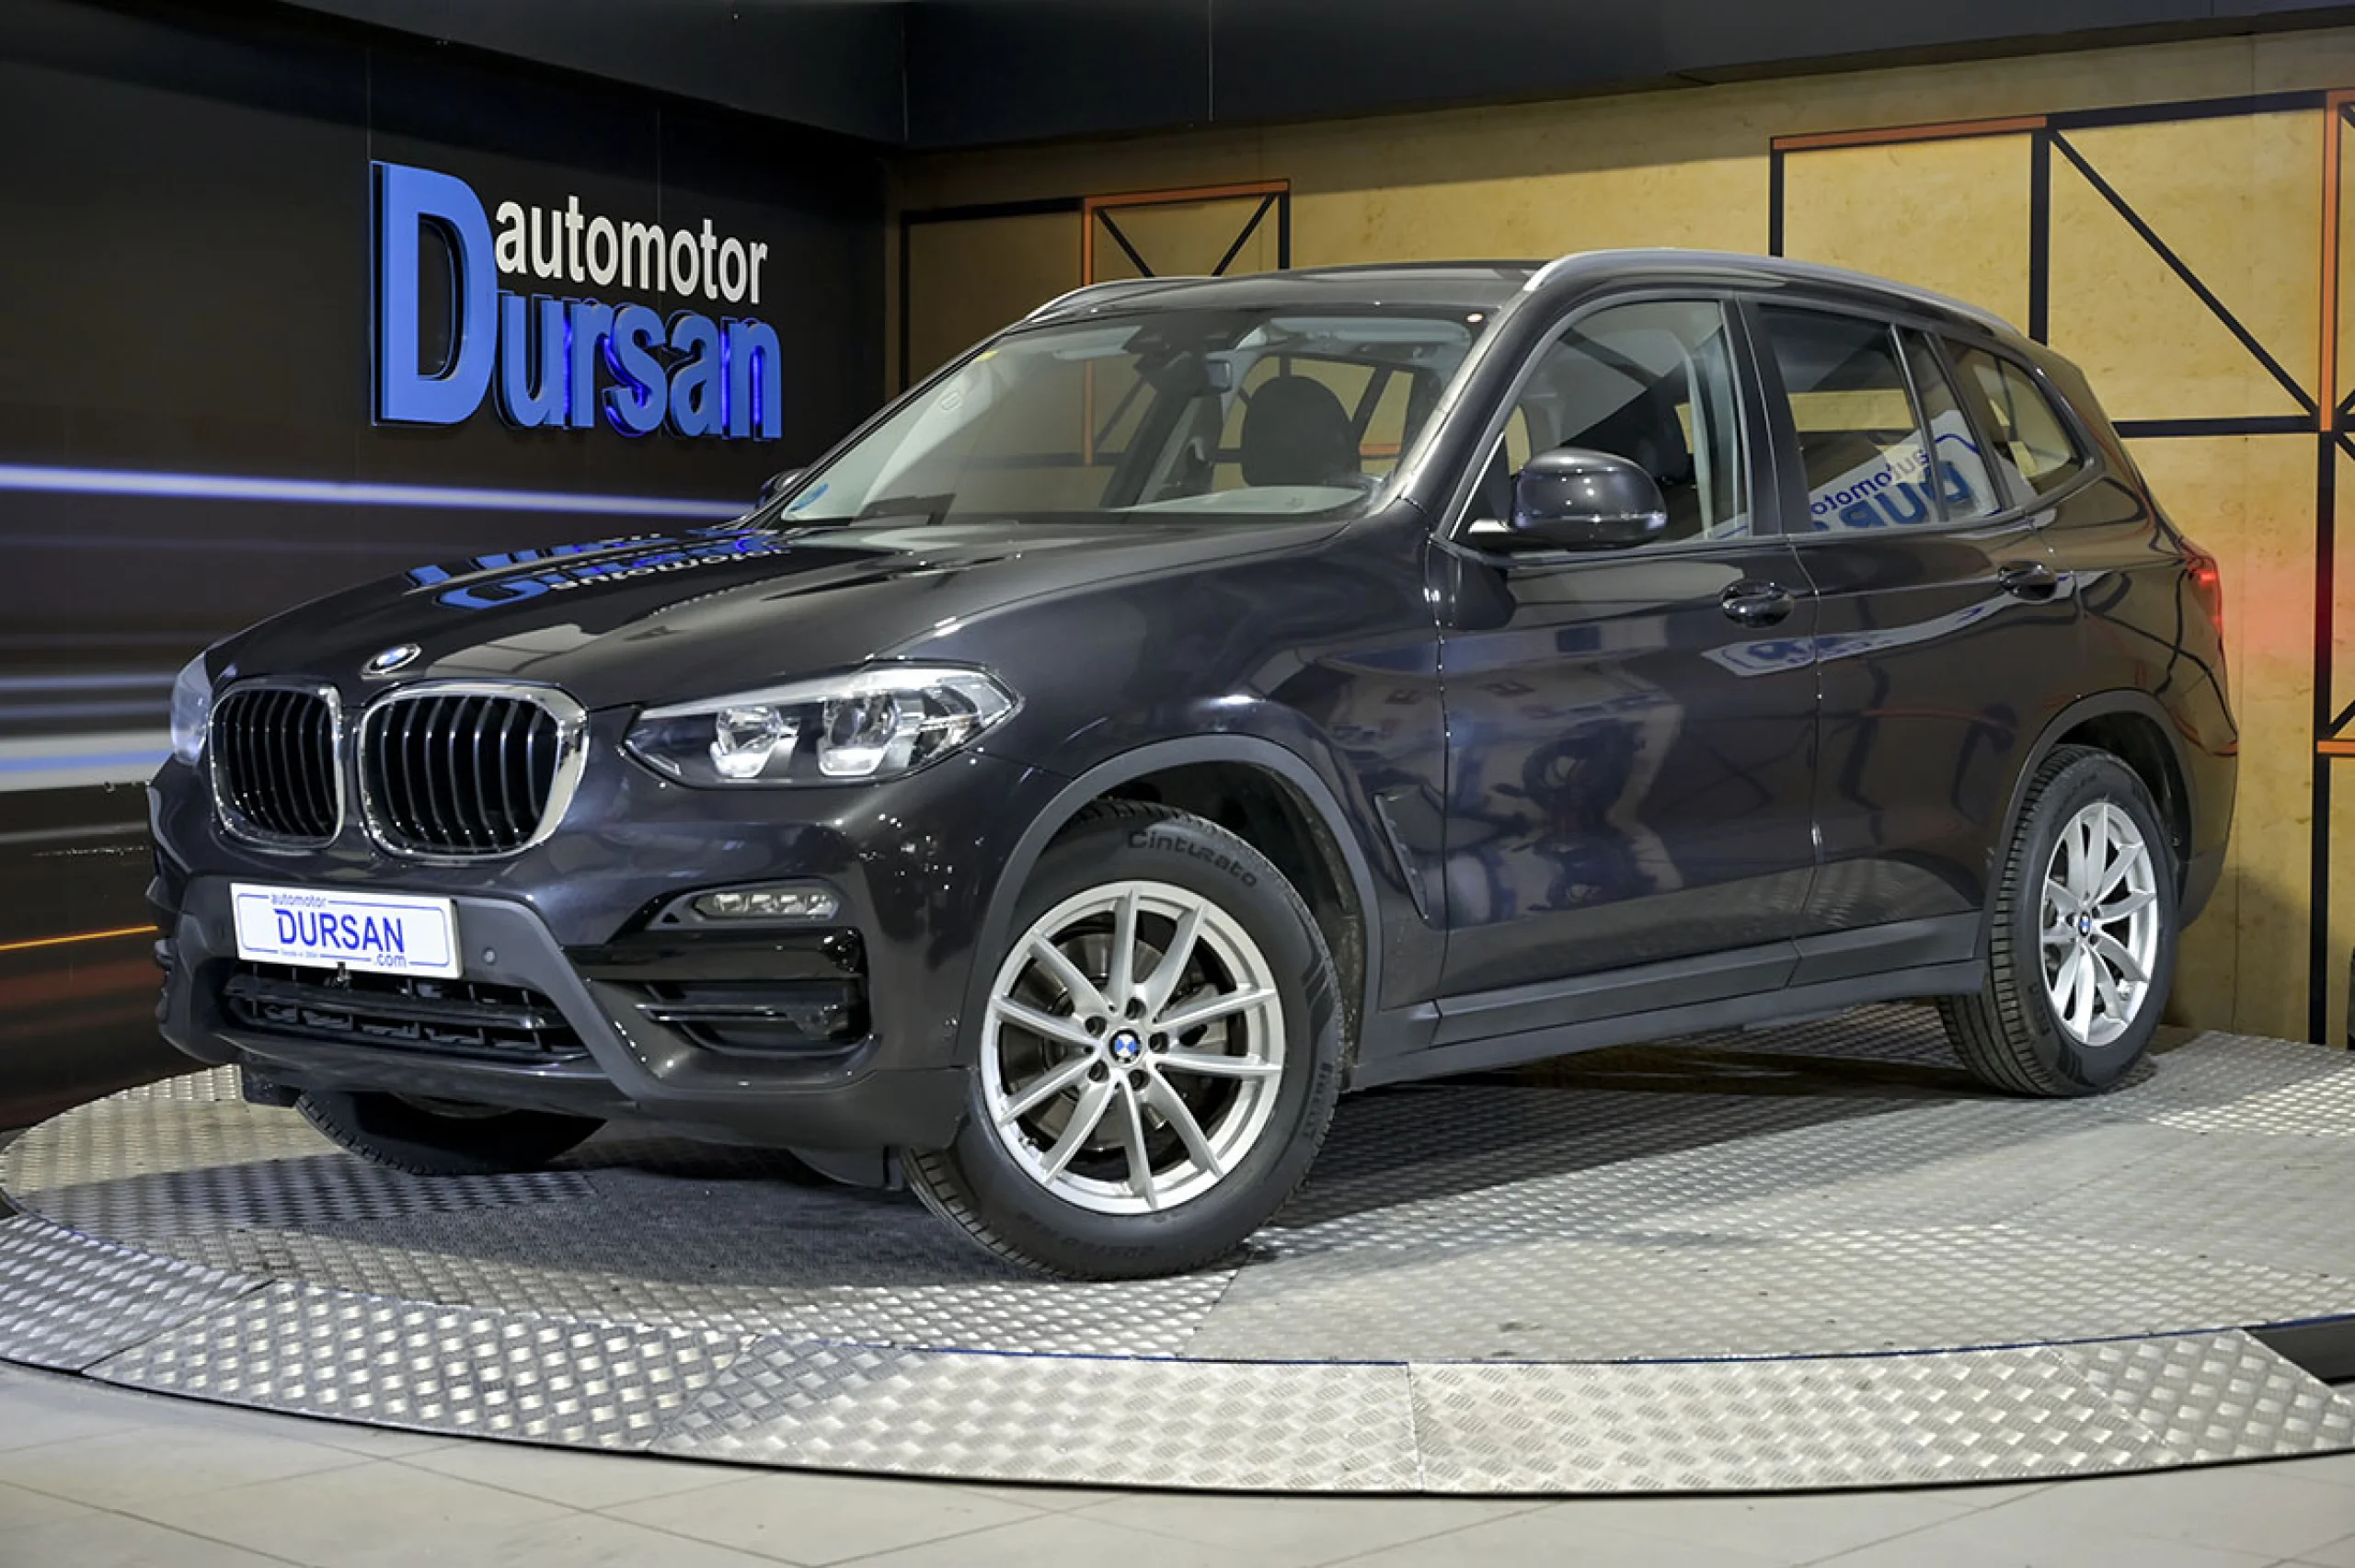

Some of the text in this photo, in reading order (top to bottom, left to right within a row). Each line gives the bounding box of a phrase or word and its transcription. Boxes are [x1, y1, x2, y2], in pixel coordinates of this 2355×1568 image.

[494, 194, 768, 304] automotor
[370, 160, 782, 442] Dursan
[270, 893, 327, 909] automotor
[273, 908, 405, 954] DURSAN
